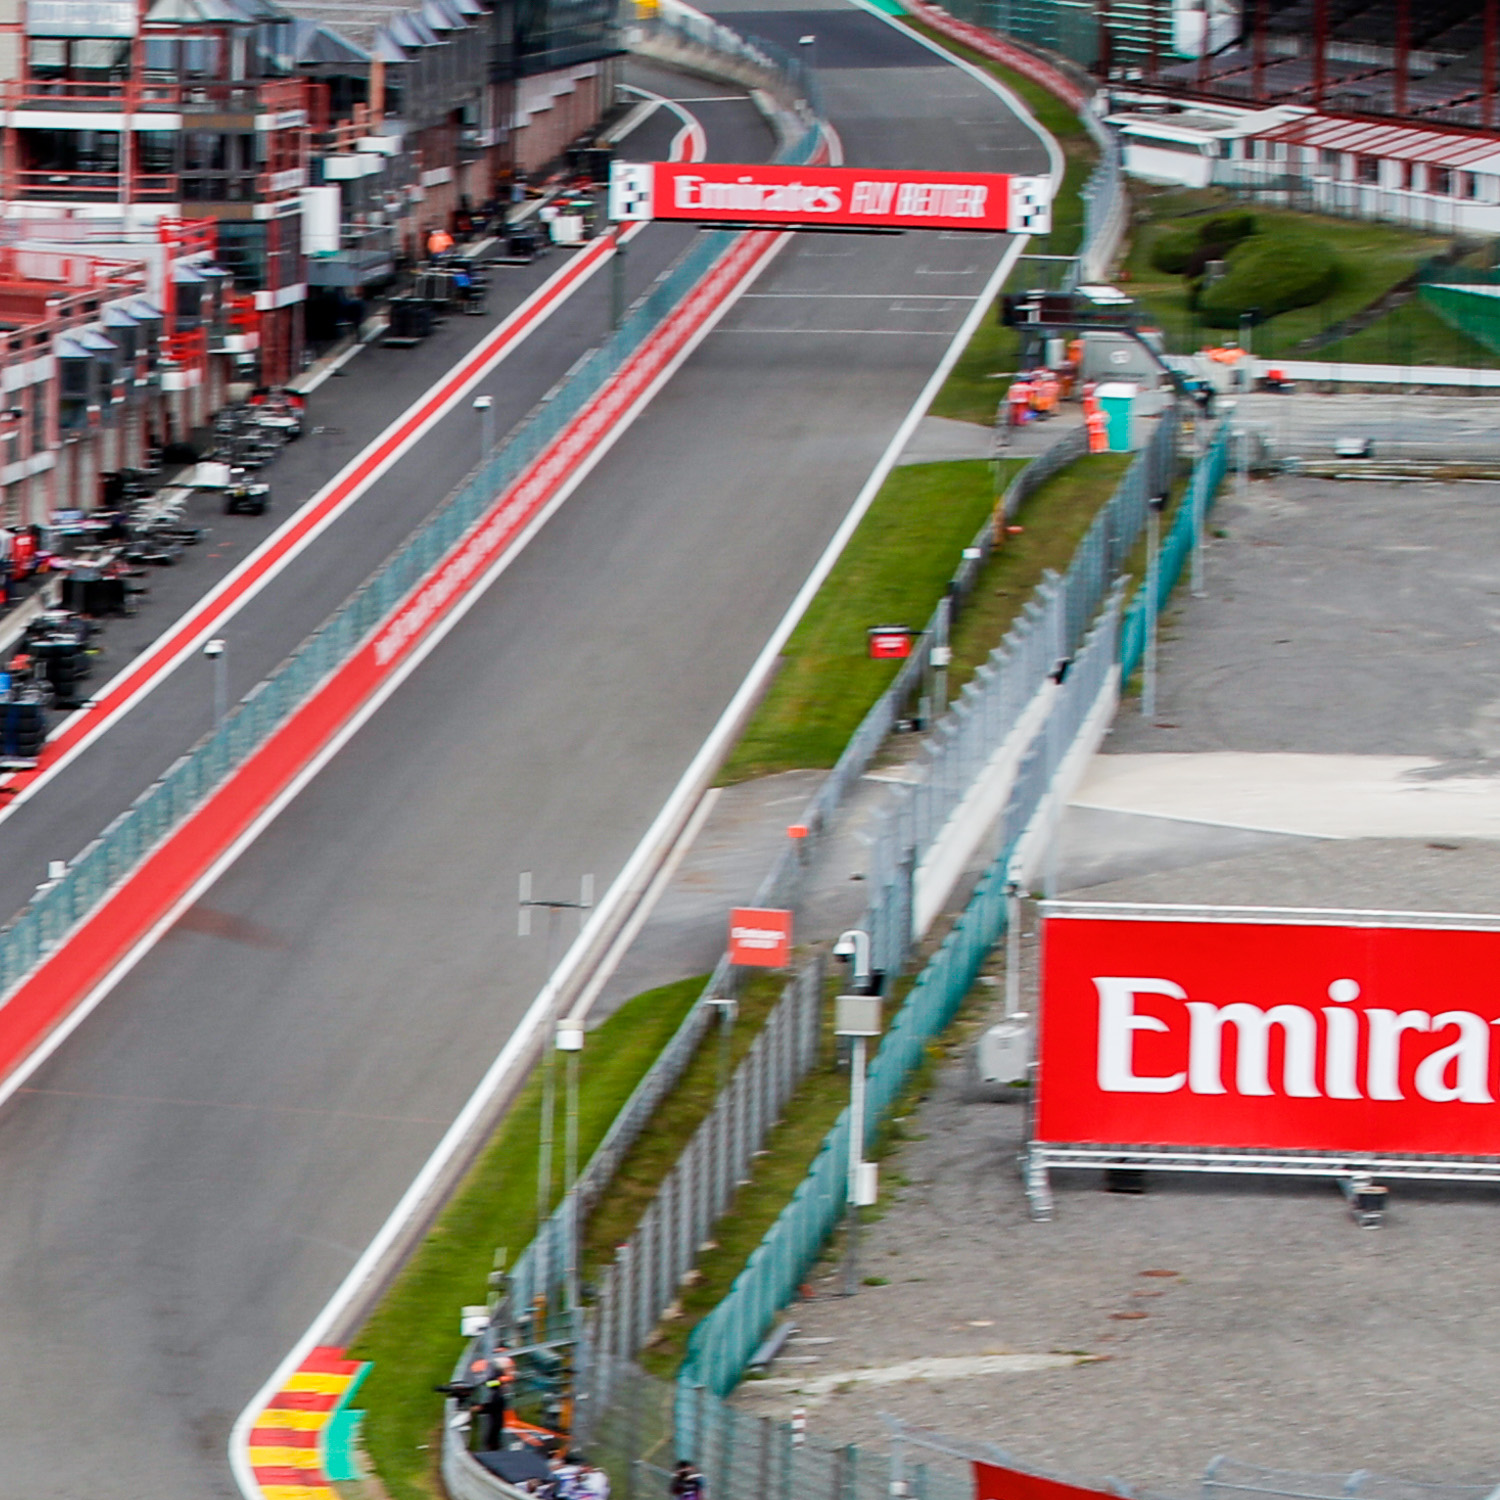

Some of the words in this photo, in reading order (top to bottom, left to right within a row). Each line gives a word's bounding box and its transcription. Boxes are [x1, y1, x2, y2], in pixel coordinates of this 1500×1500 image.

[674, 175, 841, 213] Emirates
[849, 181, 898, 215] FLY
[895, 182, 988, 218] BETTER
[1091, 976, 1500, 1104] Emira
